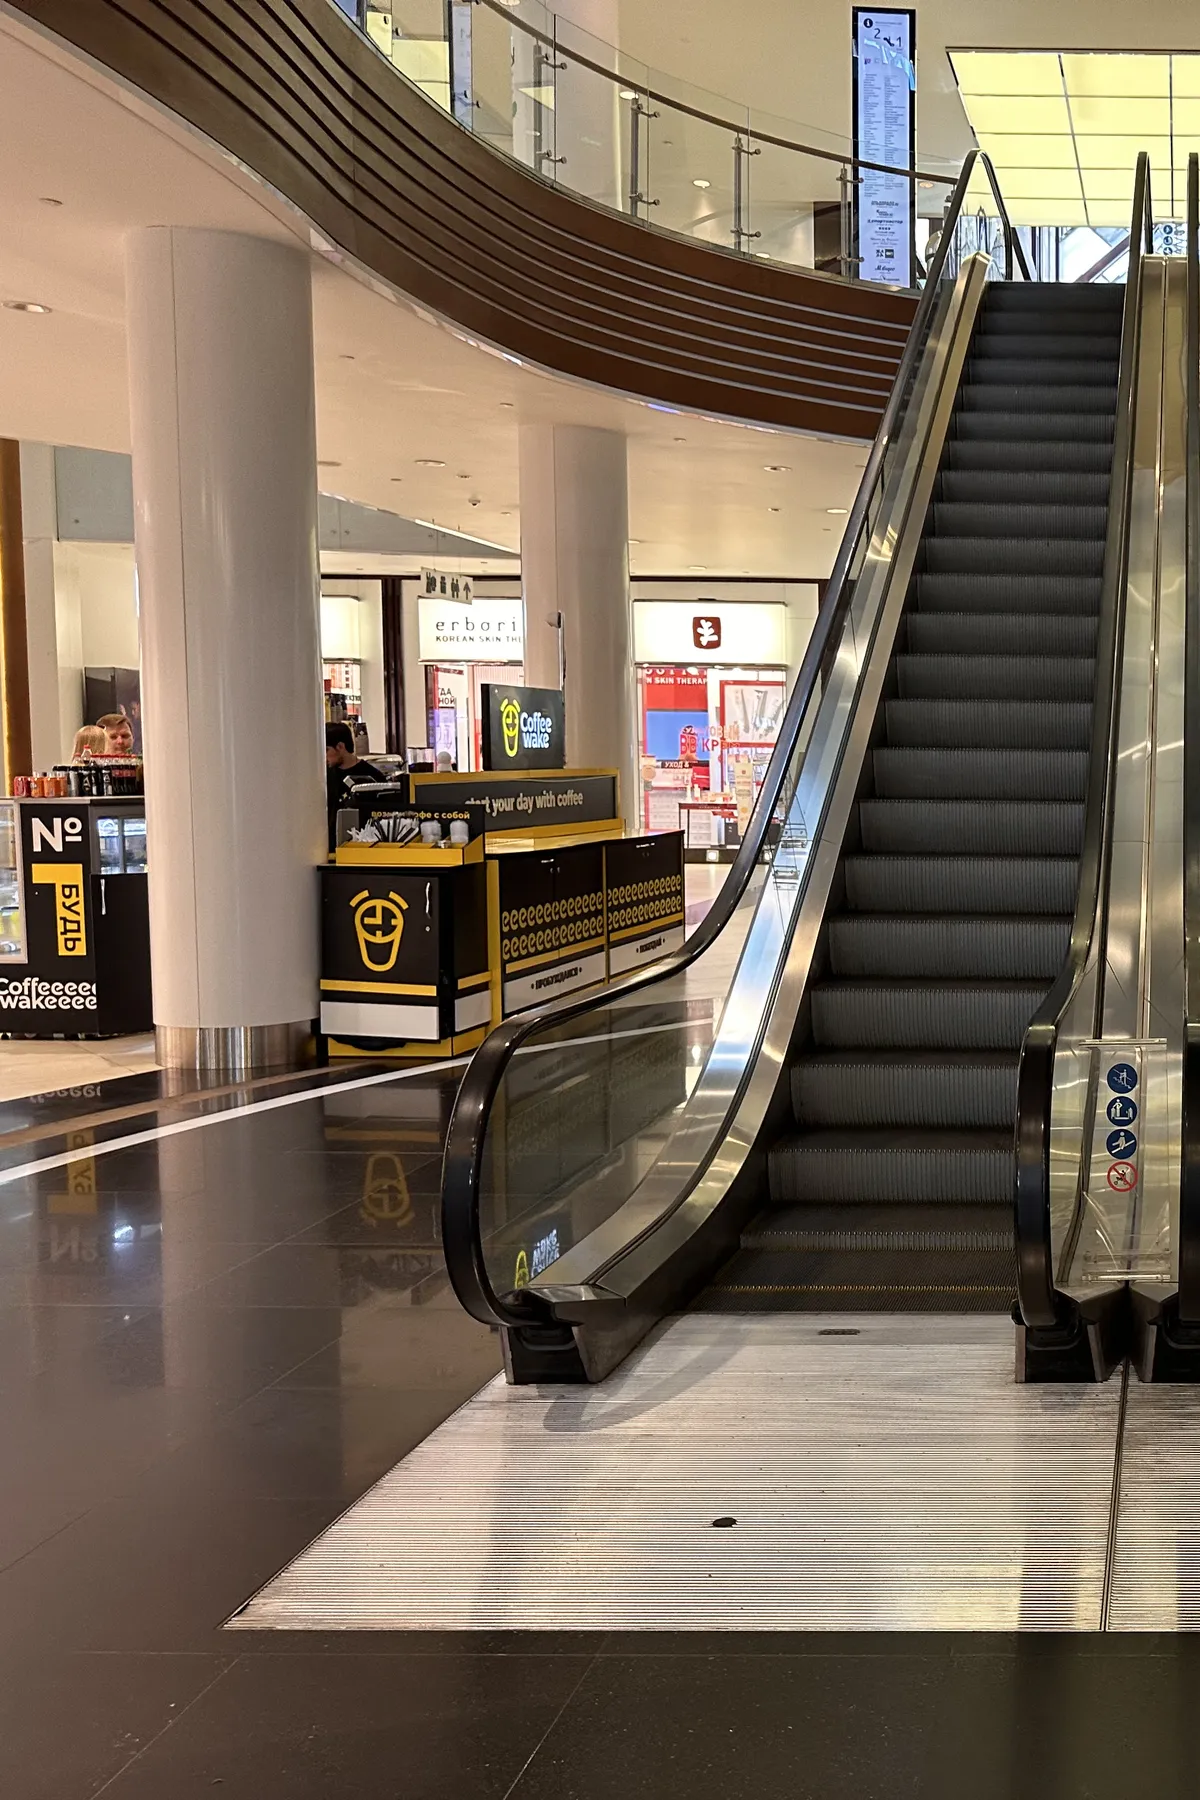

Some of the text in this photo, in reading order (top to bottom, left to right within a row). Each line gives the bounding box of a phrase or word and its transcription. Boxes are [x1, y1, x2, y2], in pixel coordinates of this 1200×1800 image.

[436, 617, 516, 631] erbori
[520, 712, 552, 735] Coffee
[522, 733, 550, 749] wake
[492, 797, 514, 816] your
[516, 792, 533, 813] day
[536, 790, 555, 808] with
[557, 790, 583, 806] coffee
[60, 884, 82, 952] БУДЬ
